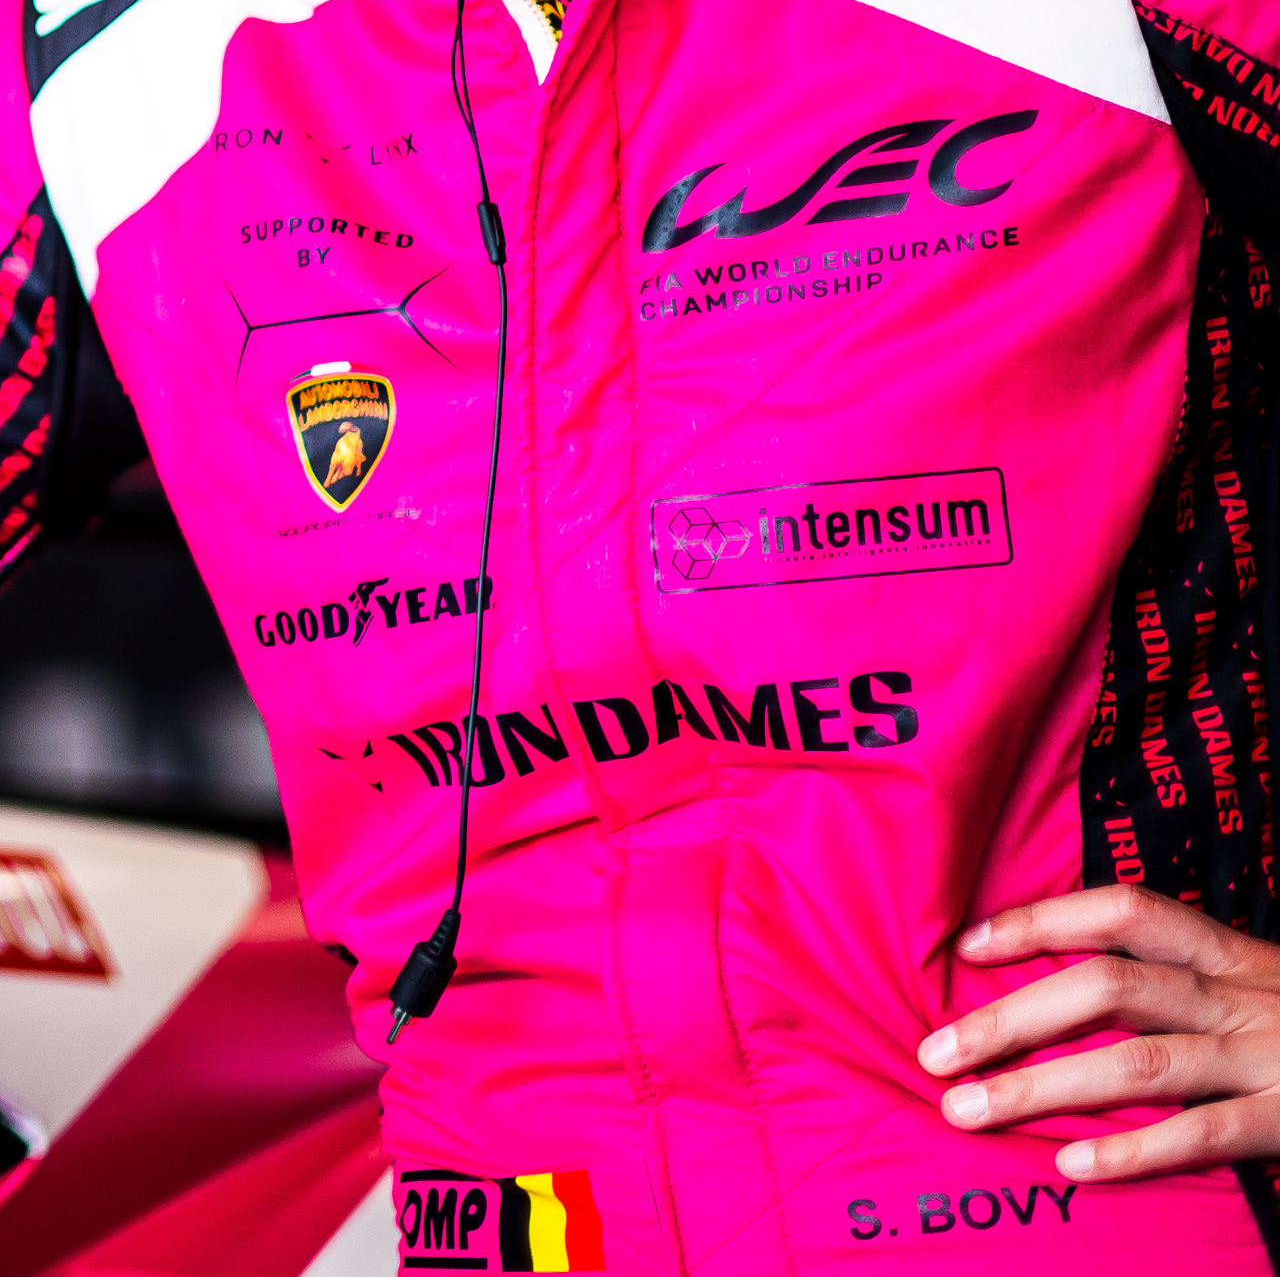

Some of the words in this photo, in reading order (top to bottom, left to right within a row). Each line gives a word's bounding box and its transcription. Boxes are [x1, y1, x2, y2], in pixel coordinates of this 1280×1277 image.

[209, 128, 283, 152] RON
[1206, 95, 1280, 147] RON
[641, 109, 1039, 253] WEC
[241, 217, 414, 248] SUPPORTED
[297, 247, 331, 267] BY
[640, 272, 683, 295] FIA
[694, 255, 811, 286] WORLD
[823, 227, 1020, 271] ENDURANCE
[640, 272, 884, 322] CHAMPIONSHIP
[1205, 315, 1232, 409] IRON
[298, 398, 389, 432] LAMBORGHINI
[300, 380, 380, 409] AUTOMOBILI
[759, 498, 991, 555] intensum
[1212, 470, 1257, 599] DAMES
[1134, 588, 1171, 682] IRON
[385, 703, 570, 787] IRON
[571, 671, 919, 763] DAMES
[1140, 690, 1187, 810] DAMES
[1191, 705, 1244, 835] DAMES
[1103, 815, 1145, 884] IRO
[400, 1187, 488, 1250] OMP
[847, 1198, 898, 1240] S.
[917, 1184, 1078, 1235] BOVY
